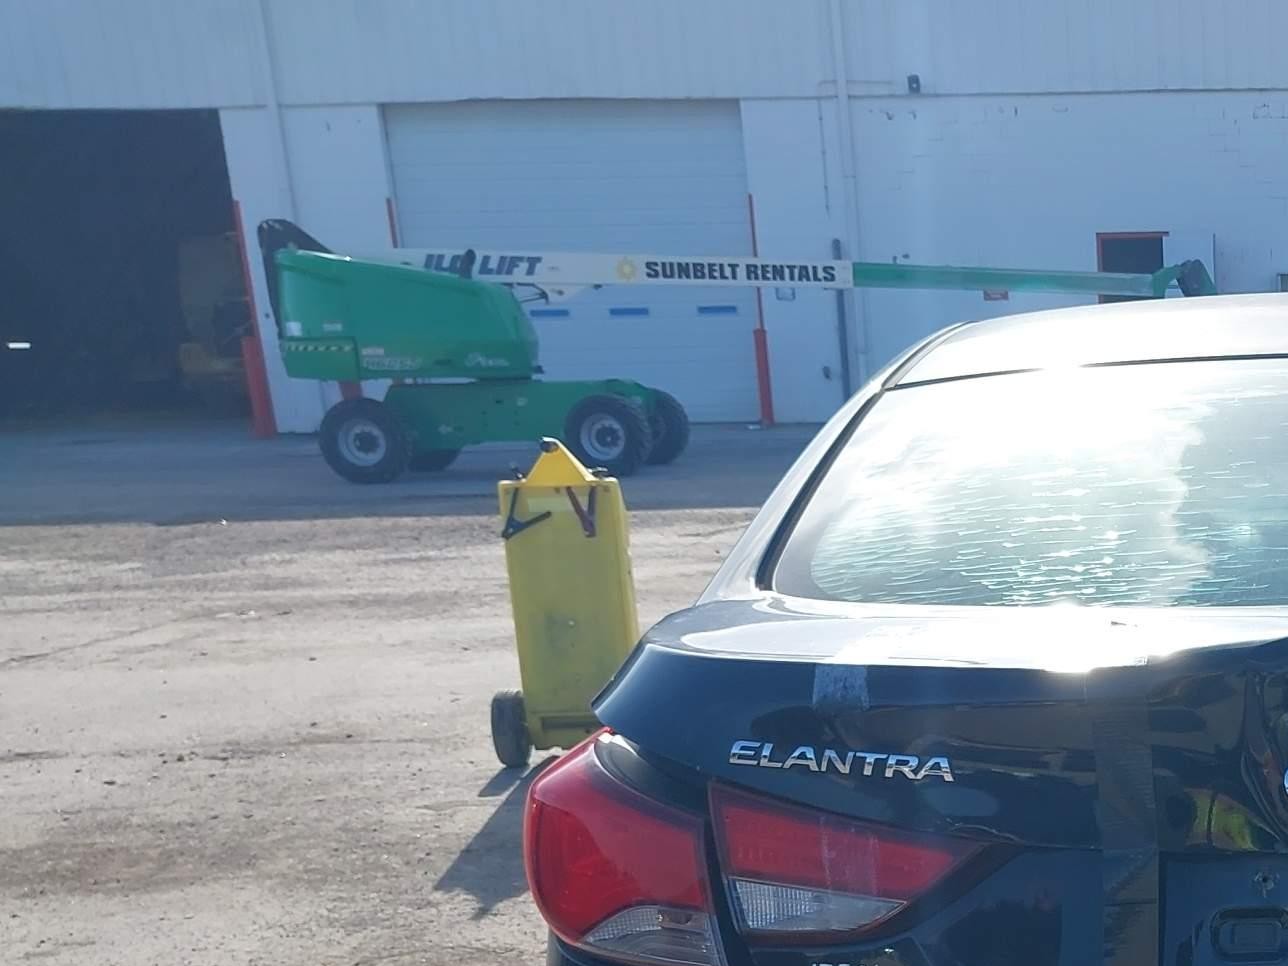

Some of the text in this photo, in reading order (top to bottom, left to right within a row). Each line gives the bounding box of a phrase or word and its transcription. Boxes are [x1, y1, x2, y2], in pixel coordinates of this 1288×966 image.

[478, 255, 543, 276] LIFT
[645, 261, 836, 282] SUNBELT RENTALS
[729, 740, 954, 782] ELANTRA
